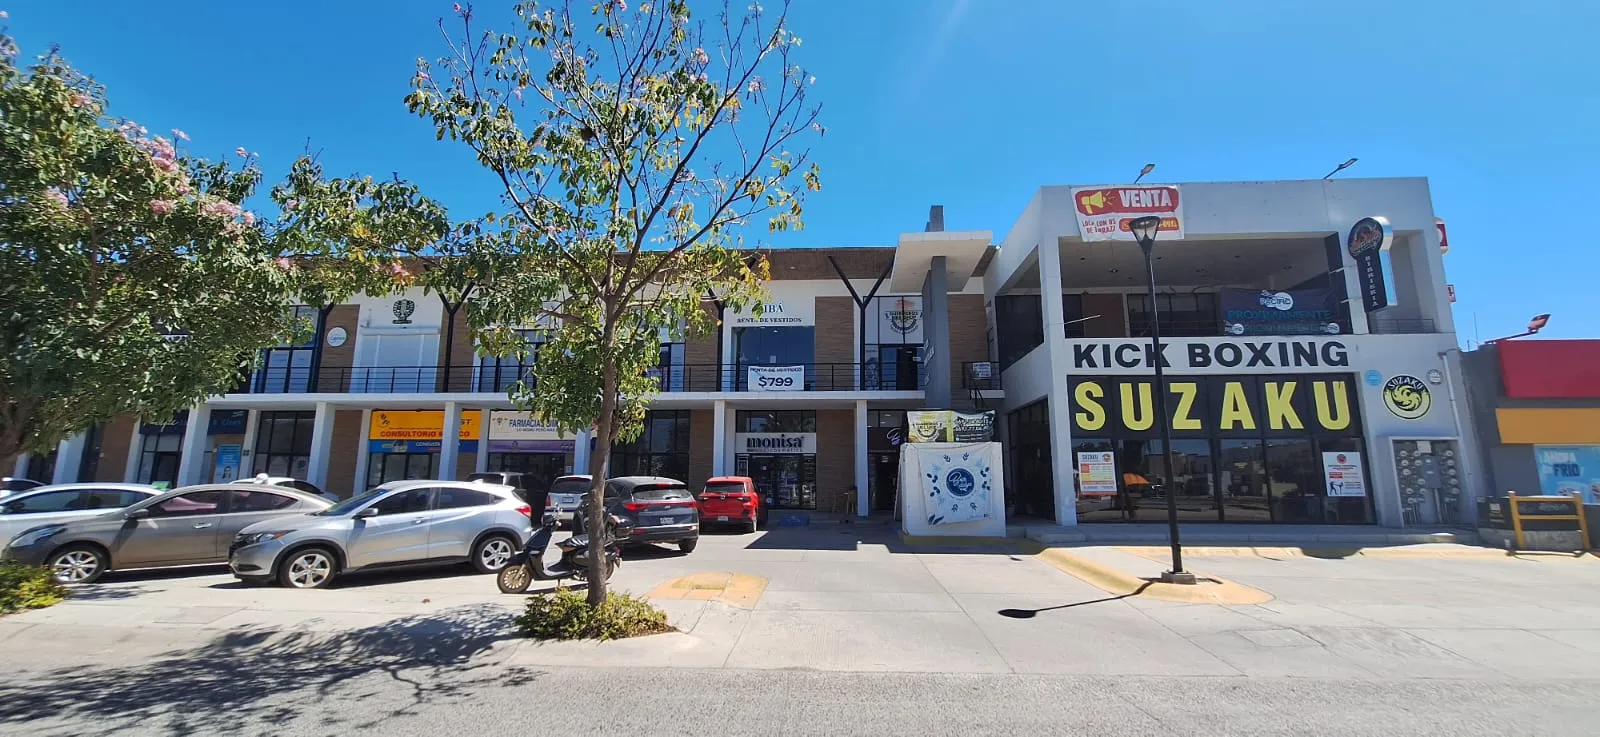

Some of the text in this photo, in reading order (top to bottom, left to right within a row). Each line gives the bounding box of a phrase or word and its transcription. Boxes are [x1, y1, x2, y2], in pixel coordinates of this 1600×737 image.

[1118, 189, 1172, 208] VENTA
[1073, 341, 1349, 369] KICK BOXING
[758, 375, 794, 388] $799
[1388, 376, 1424, 390] SUZAKU
[1073, 381, 1351, 431] SUZAKU
[380, 430, 437, 438] CONSULTORIO
[746, 433, 802, 448] monisa
